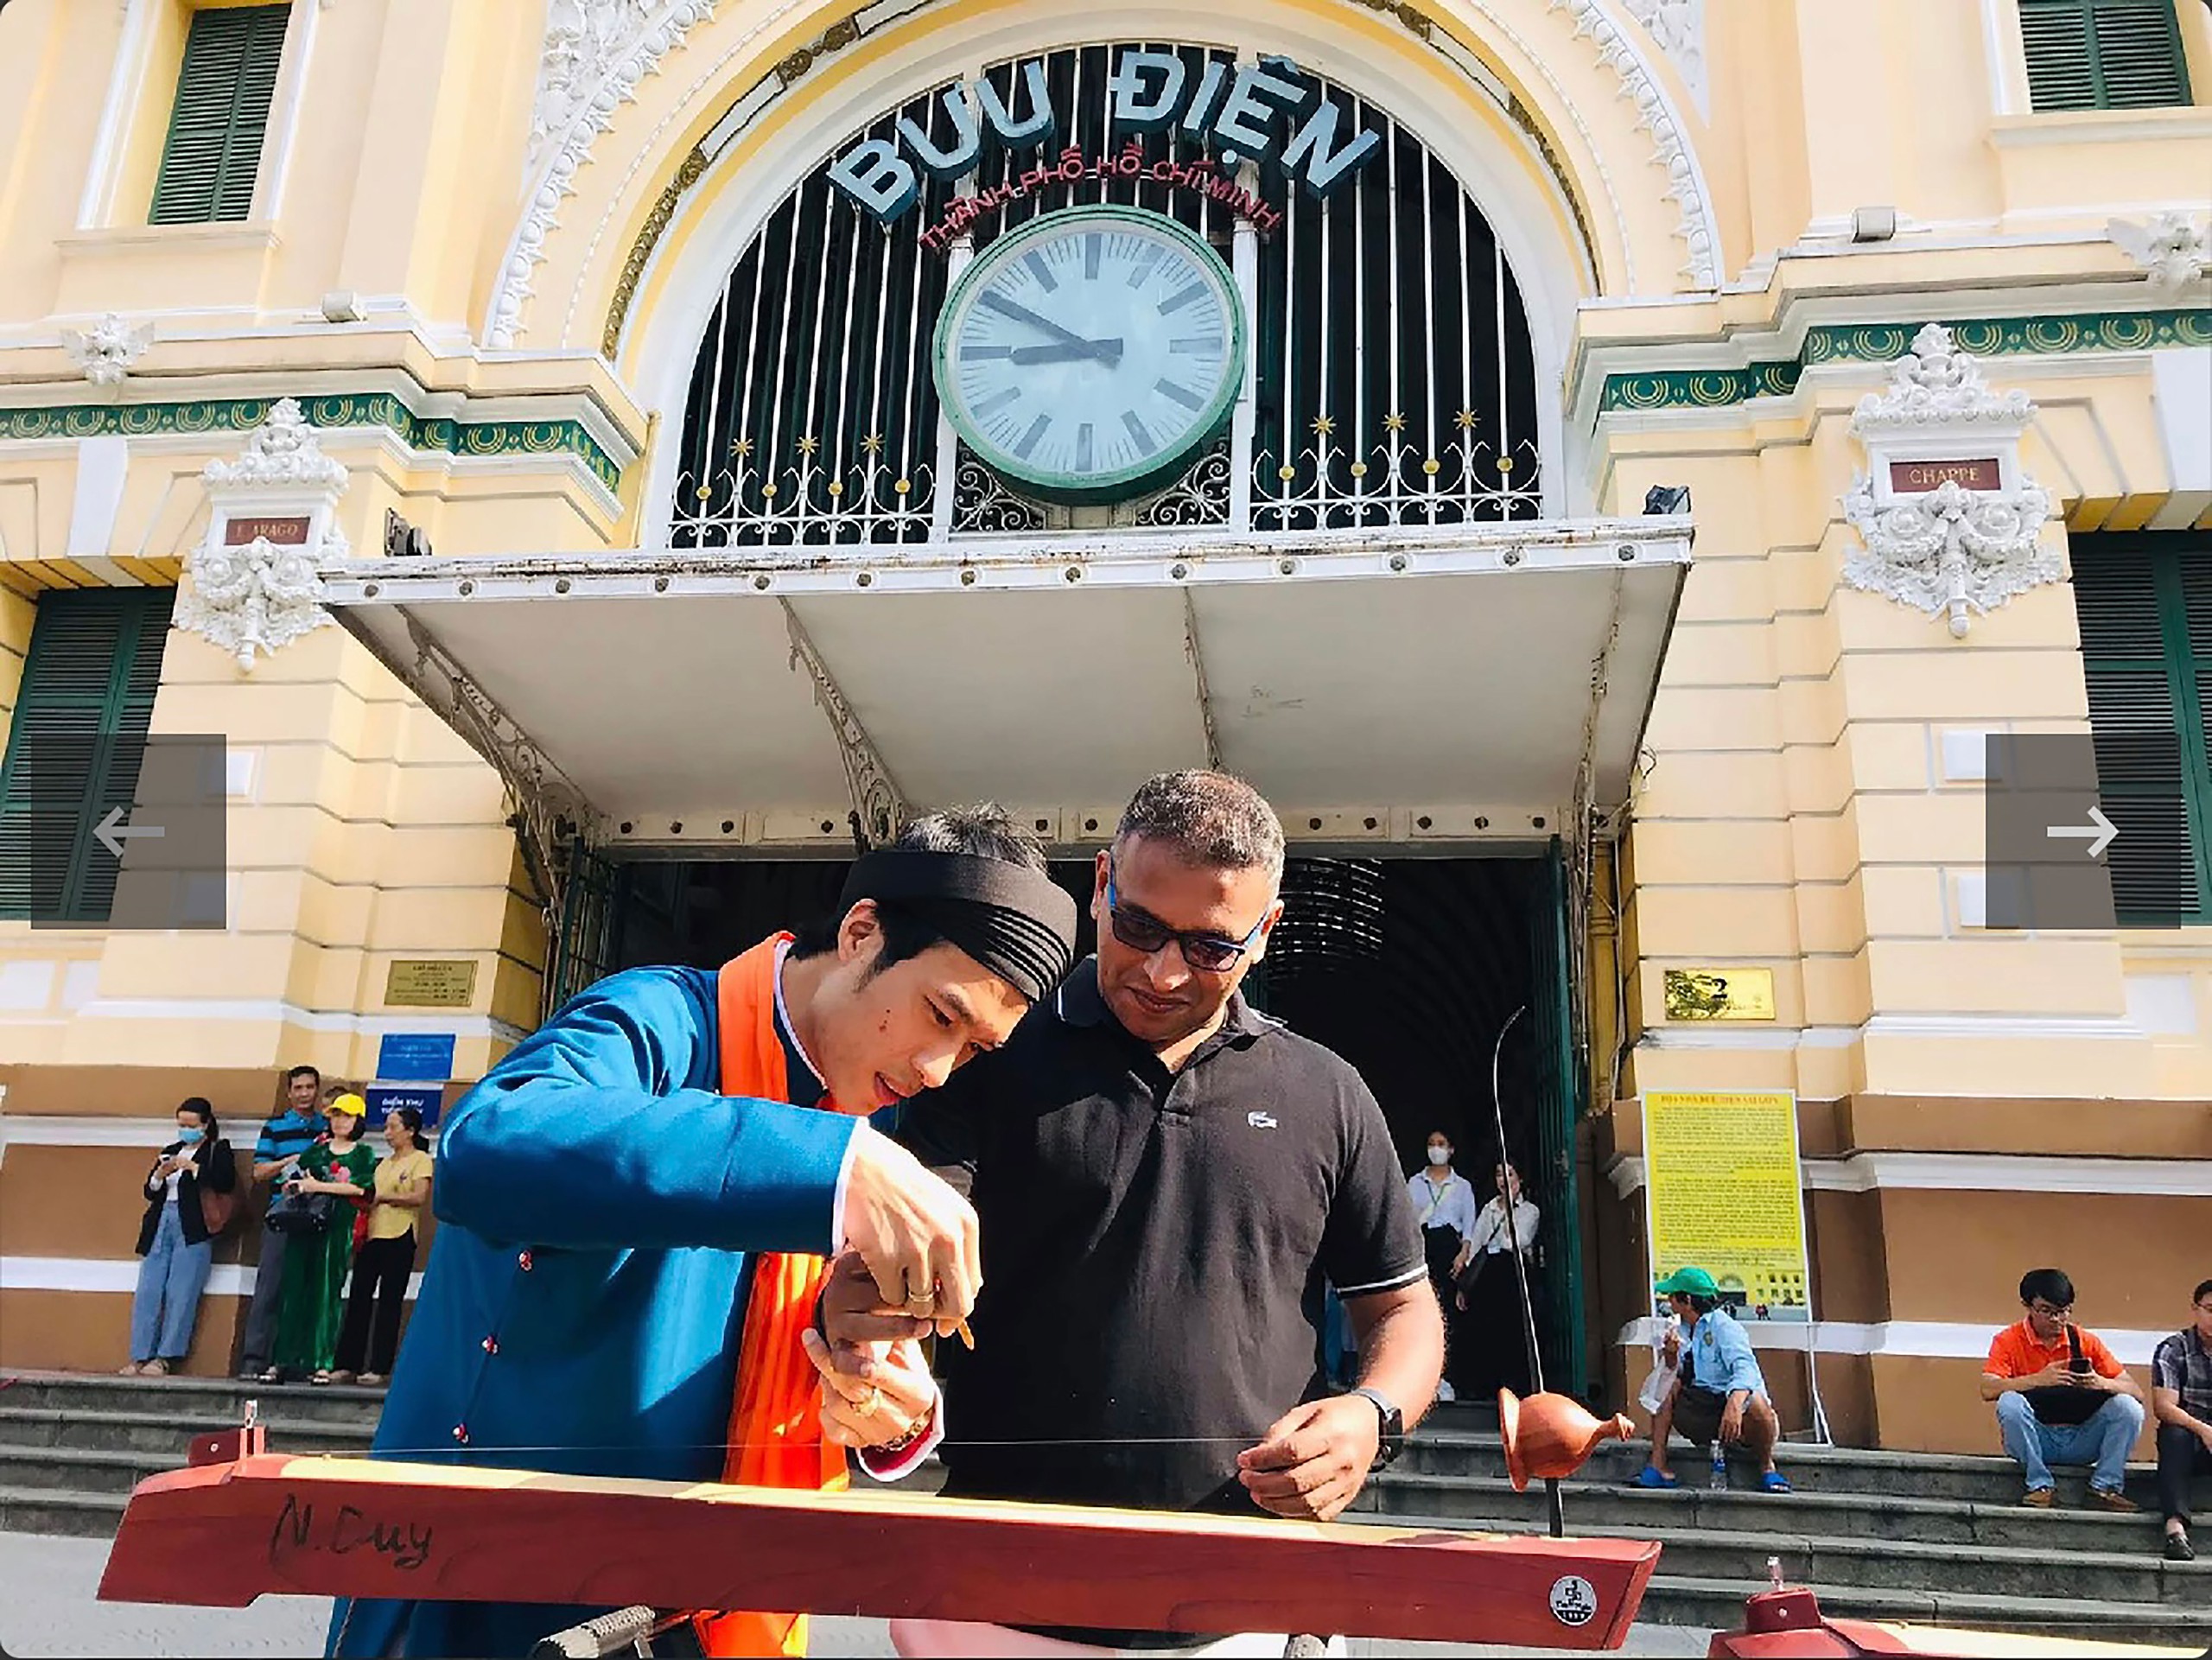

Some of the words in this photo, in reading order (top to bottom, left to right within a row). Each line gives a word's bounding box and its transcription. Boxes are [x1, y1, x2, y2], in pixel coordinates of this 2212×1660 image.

[826, 60, 1054, 219] BƯU
[1109, 50, 1380, 192] ĐIỆN
[1208, 175, 1284, 231] MINH
[1909, 467, 1980, 484] CHAPPE
